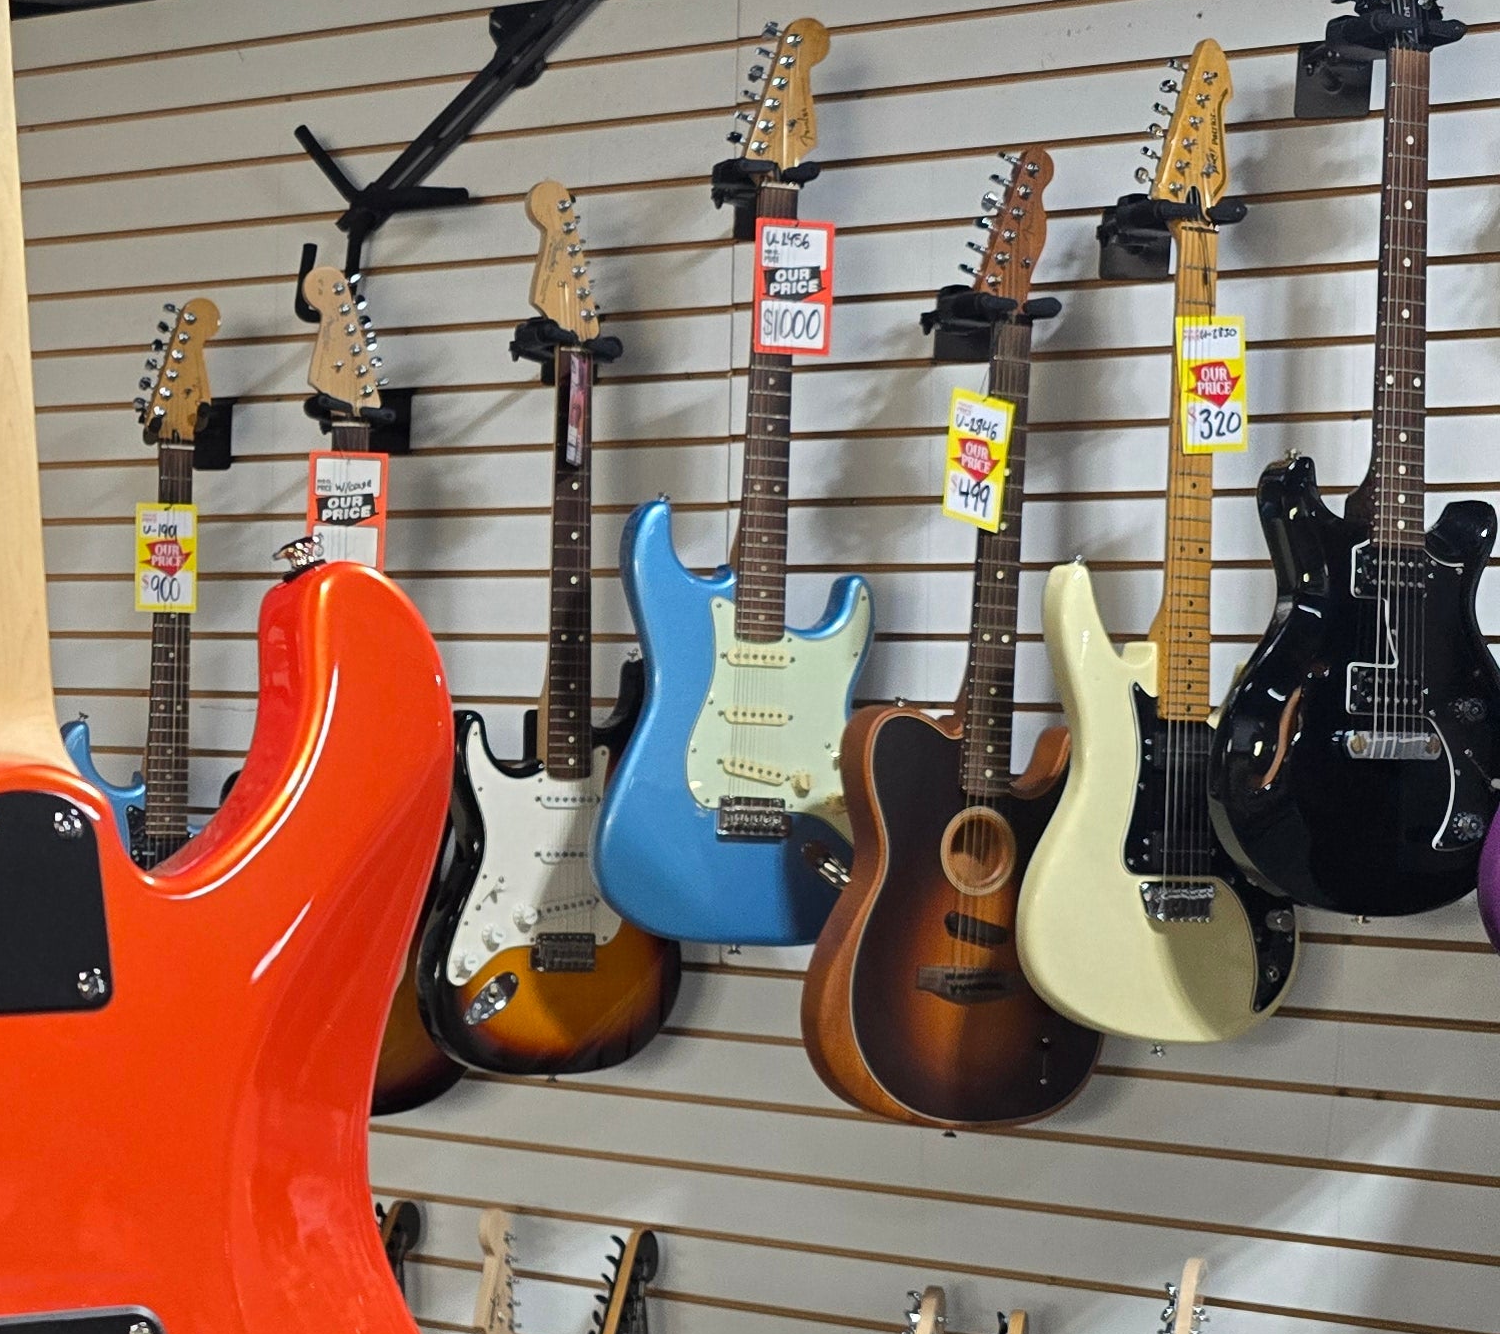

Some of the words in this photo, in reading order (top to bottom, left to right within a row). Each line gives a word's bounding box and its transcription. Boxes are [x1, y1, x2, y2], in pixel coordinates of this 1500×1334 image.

[774, 268, 810, 283] OUR
[769, 278, 819, 296] PRICE
[763, 308, 821, 342] $1000
[1201, 366, 1228, 381] OUR
[1197, 380, 1232, 396] PRICE
[965, 442, 990, 458] OUR
[961, 453, 992, 475] PRICE
[327, 496, 363, 508] OUR
[322, 505, 372, 522] PRICE
[154, 543, 180, 556] OUR
[151, 555, 182, 567] PRICE
